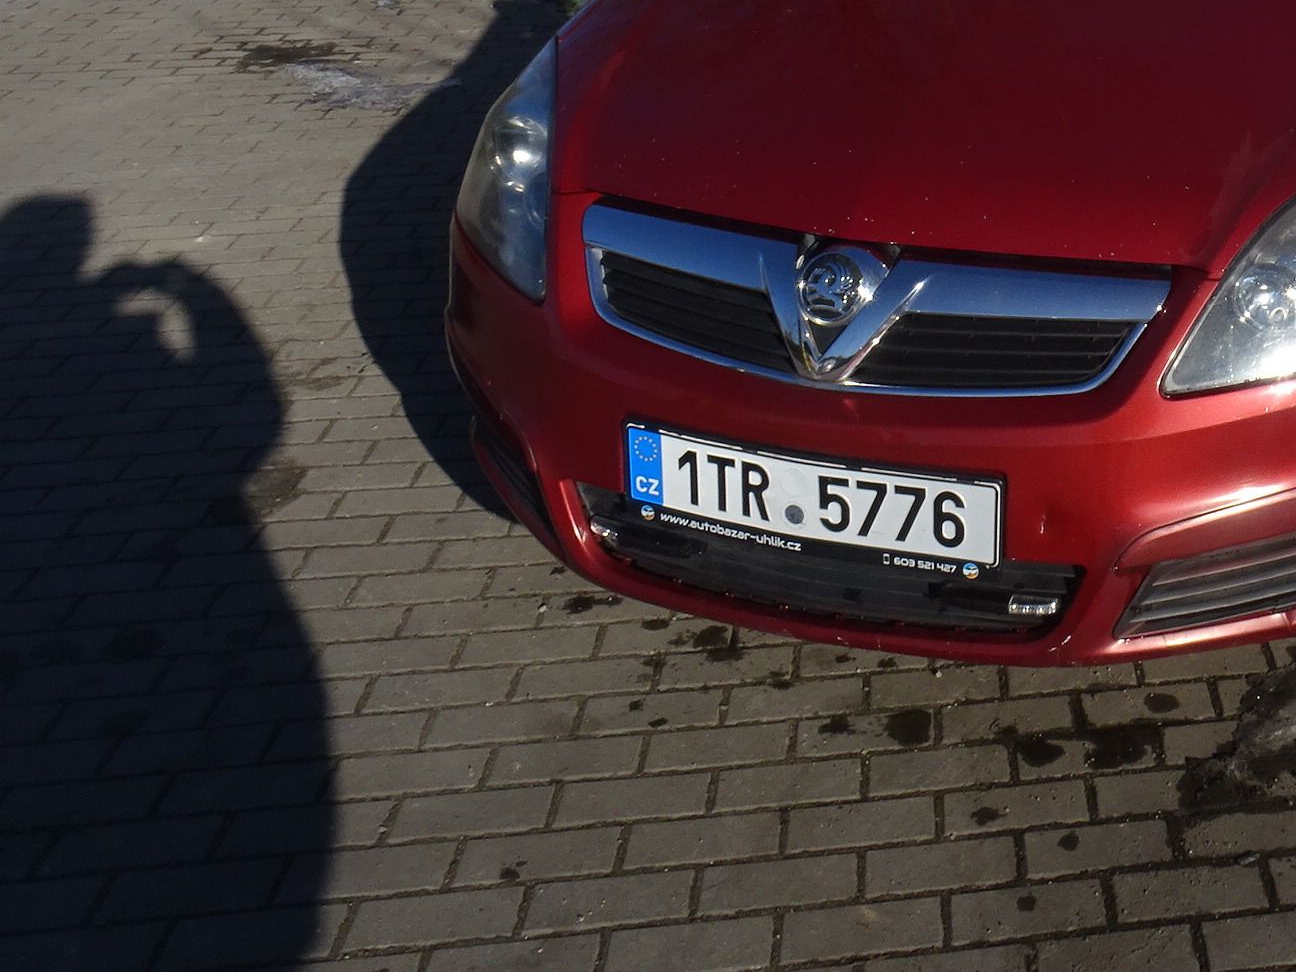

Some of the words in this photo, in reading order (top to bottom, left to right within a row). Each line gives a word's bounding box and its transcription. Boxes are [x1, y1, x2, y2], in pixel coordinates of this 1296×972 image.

[635, 475, 660, 497] CZ
[678, 449, 770, 522] 1TR
[818, 476, 965, 548] 5776
[660, 512, 802, 552] www.autobazar-uhlik.cz
